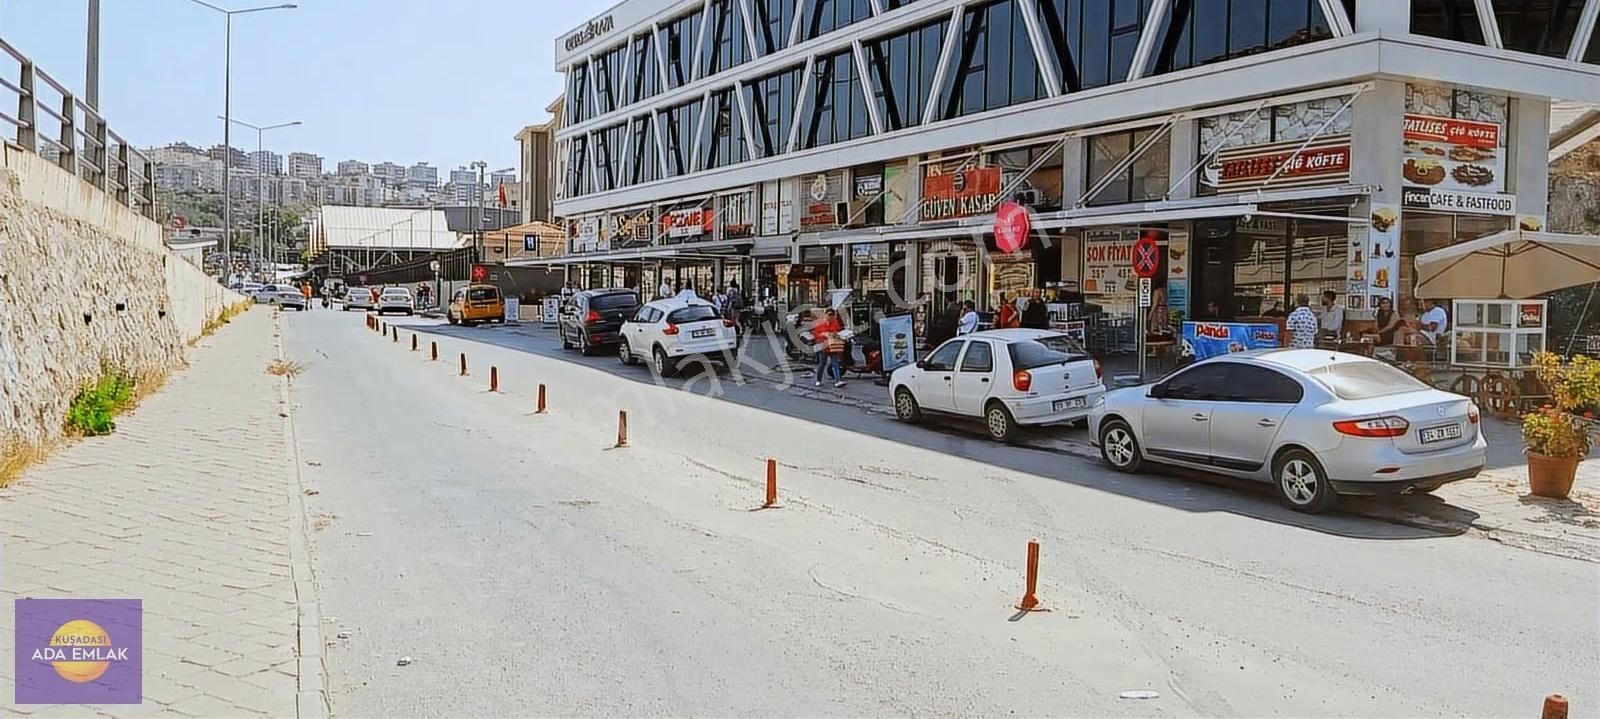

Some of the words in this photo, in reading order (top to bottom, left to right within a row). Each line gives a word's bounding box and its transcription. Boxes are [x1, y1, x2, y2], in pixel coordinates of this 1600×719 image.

[1403, 119, 1447, 135] TATLISES
[1306, 153, 1344, 170] KÖFTE
[924, 195, 955, 218] GÜVEN
[960, 193, 996, 215] KASAP
[1430, 193, 1453, 207] CAFE
[1456, 195, 1463, 208] &
[1466, 196, 1511, 211] FASTFOOD
